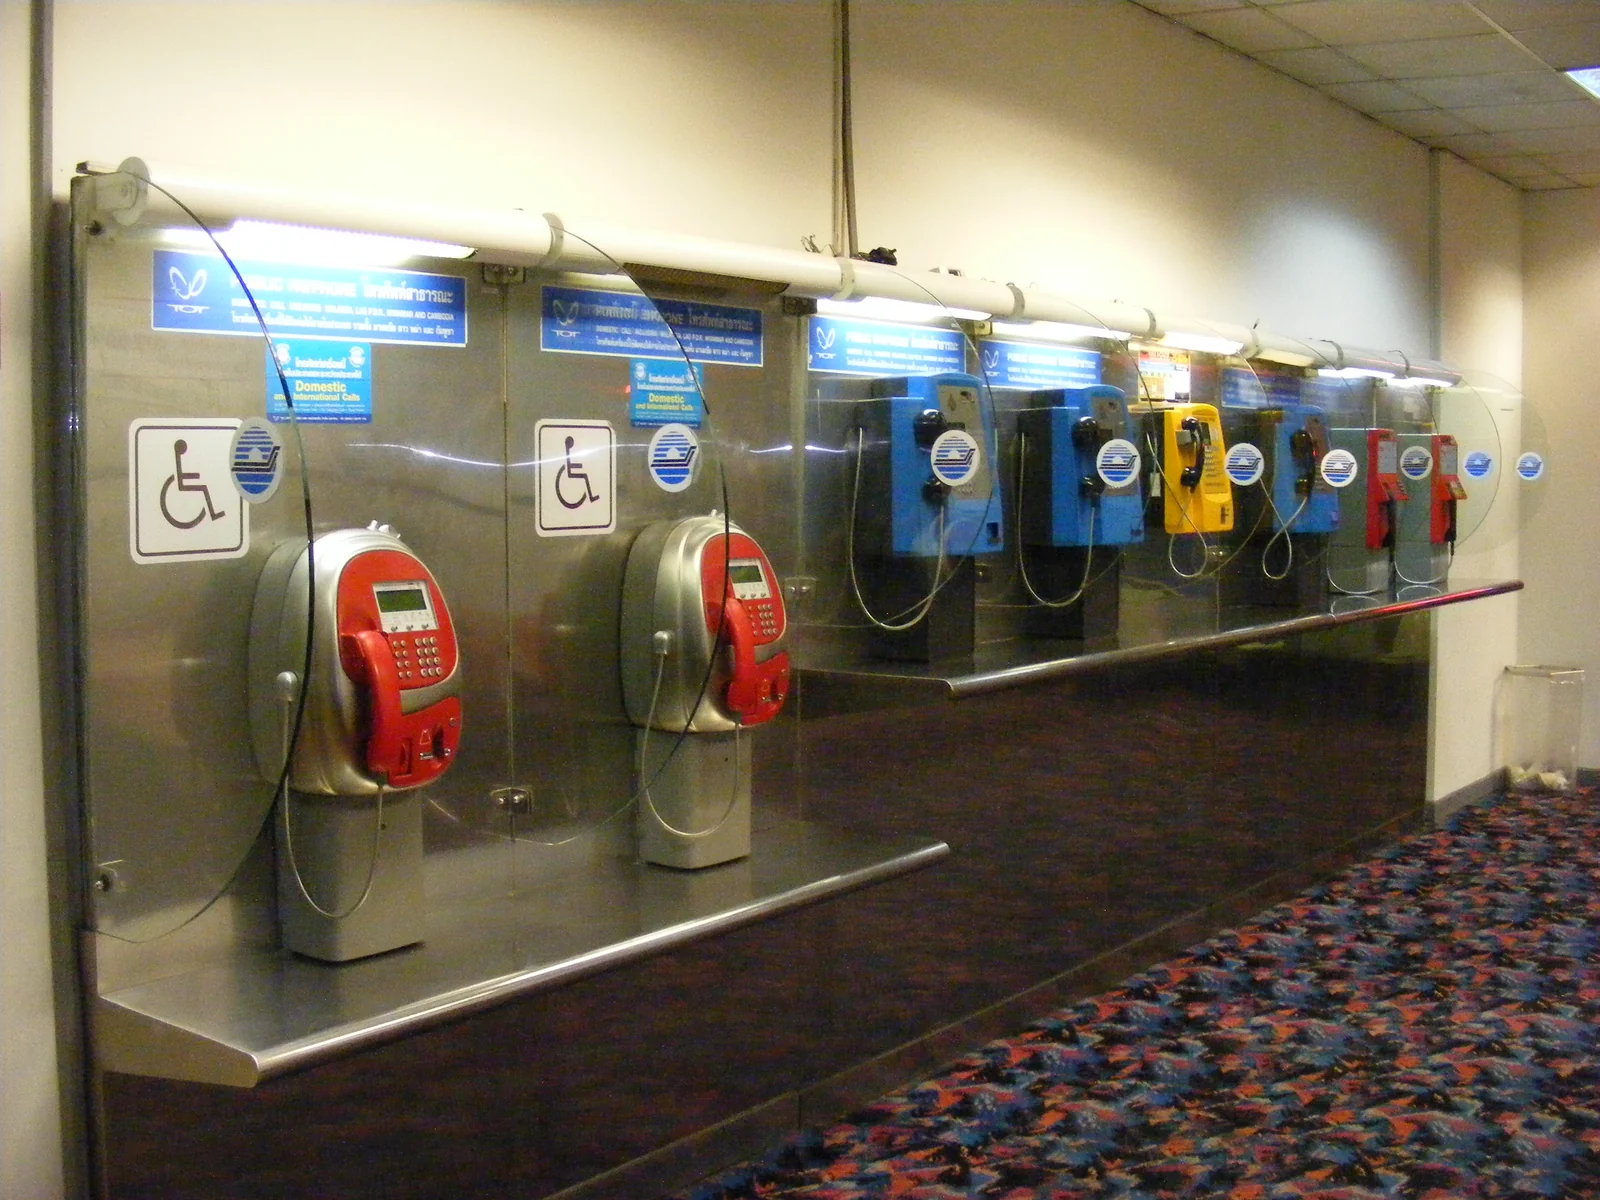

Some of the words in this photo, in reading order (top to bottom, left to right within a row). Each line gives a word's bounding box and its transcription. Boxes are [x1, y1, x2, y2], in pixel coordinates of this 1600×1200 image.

[166, 304, 210, 314] TOT
[550, 329, 582, 338] TOT
[294, 380, 347, 393] Domestic
[293, 392, 340, 402] International
[341, 393, 361, 402] Calls
[648, 392, 685, 404] Domestic
